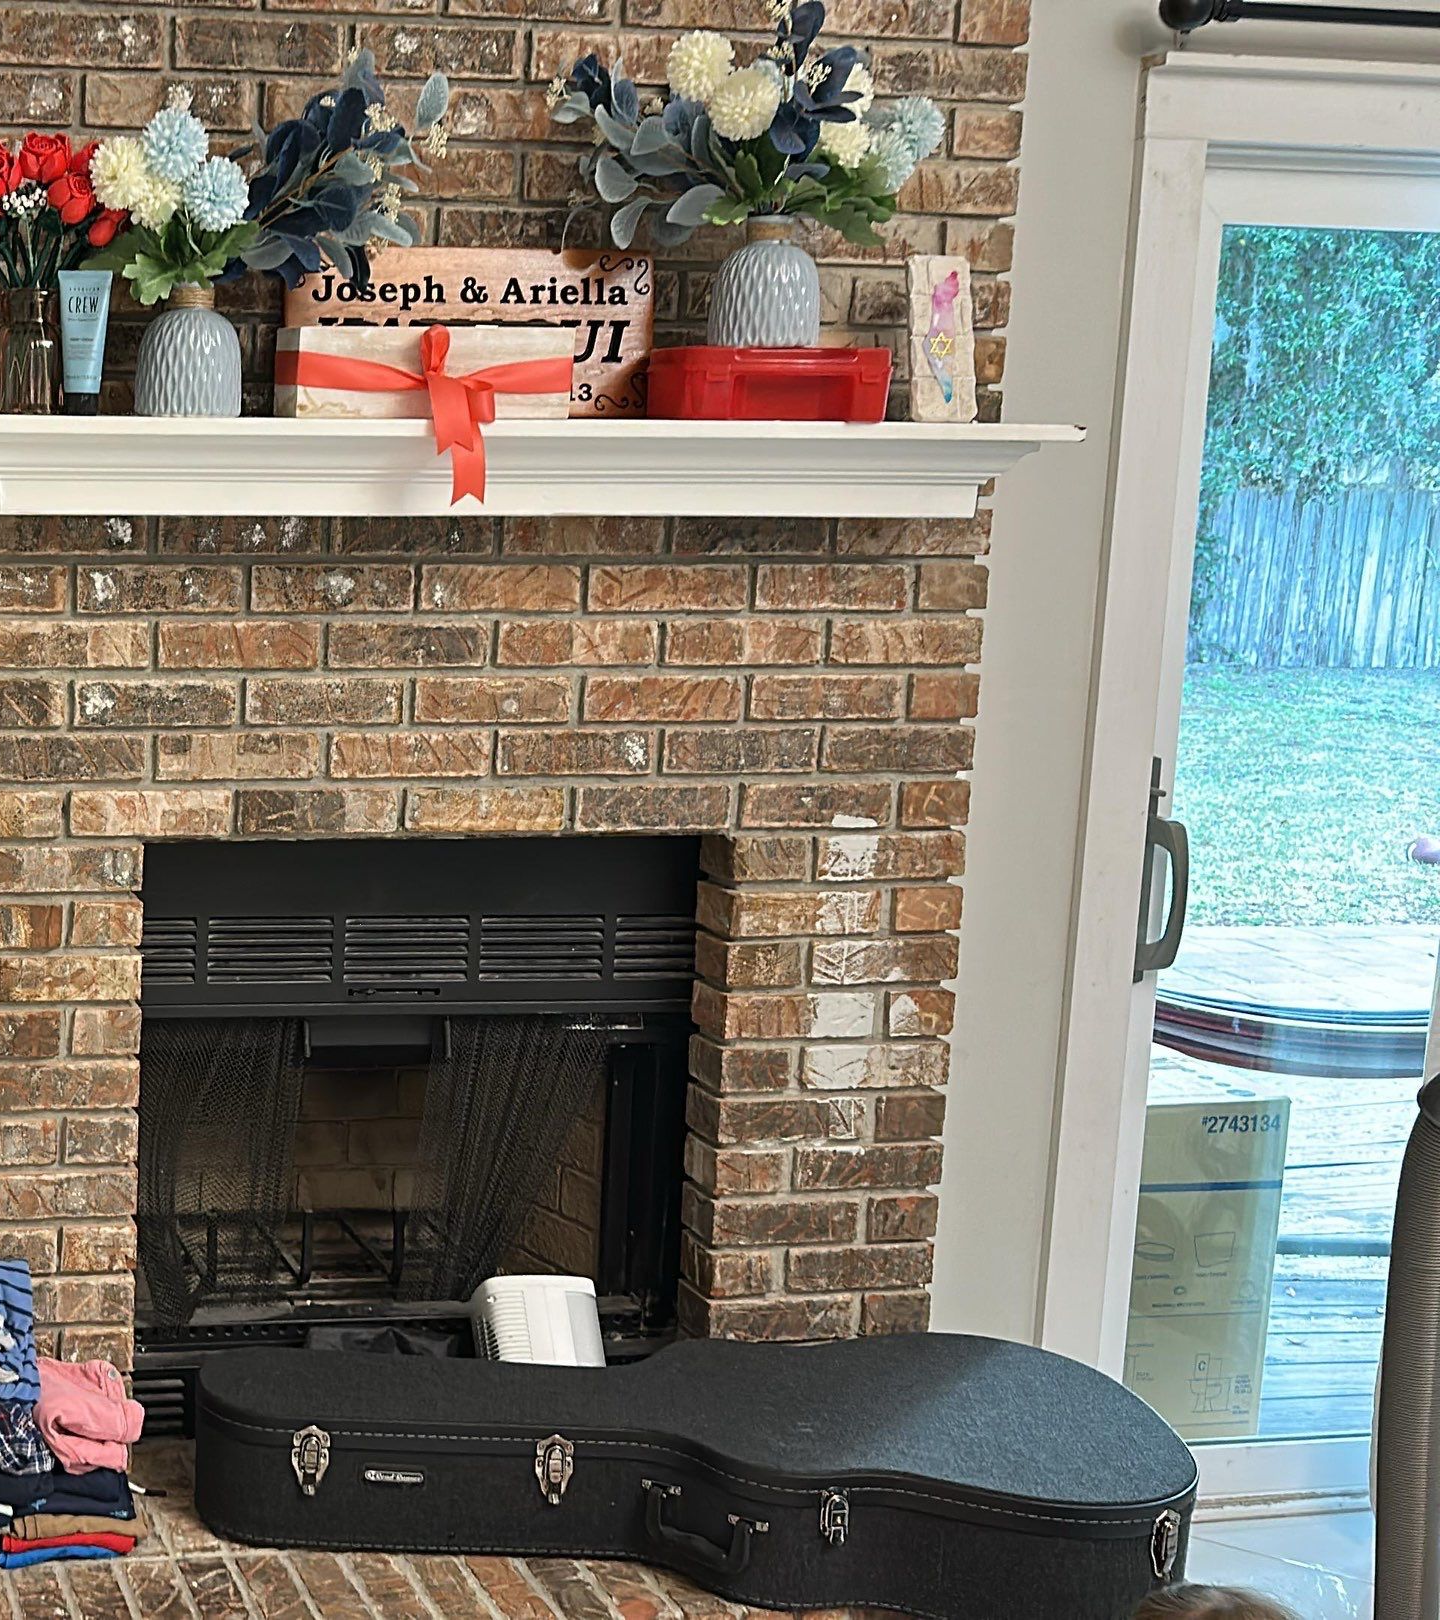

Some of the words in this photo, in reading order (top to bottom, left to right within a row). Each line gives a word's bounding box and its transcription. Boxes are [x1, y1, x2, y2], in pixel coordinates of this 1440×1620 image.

[312, 275, 446, 310] Joseph
[461, 277, 488, 303] &
[500, 278, 628, 305] Ariella
[68, 296, 99, 314] CREW
[1201, 1115, 1282, 1134] #2743134
